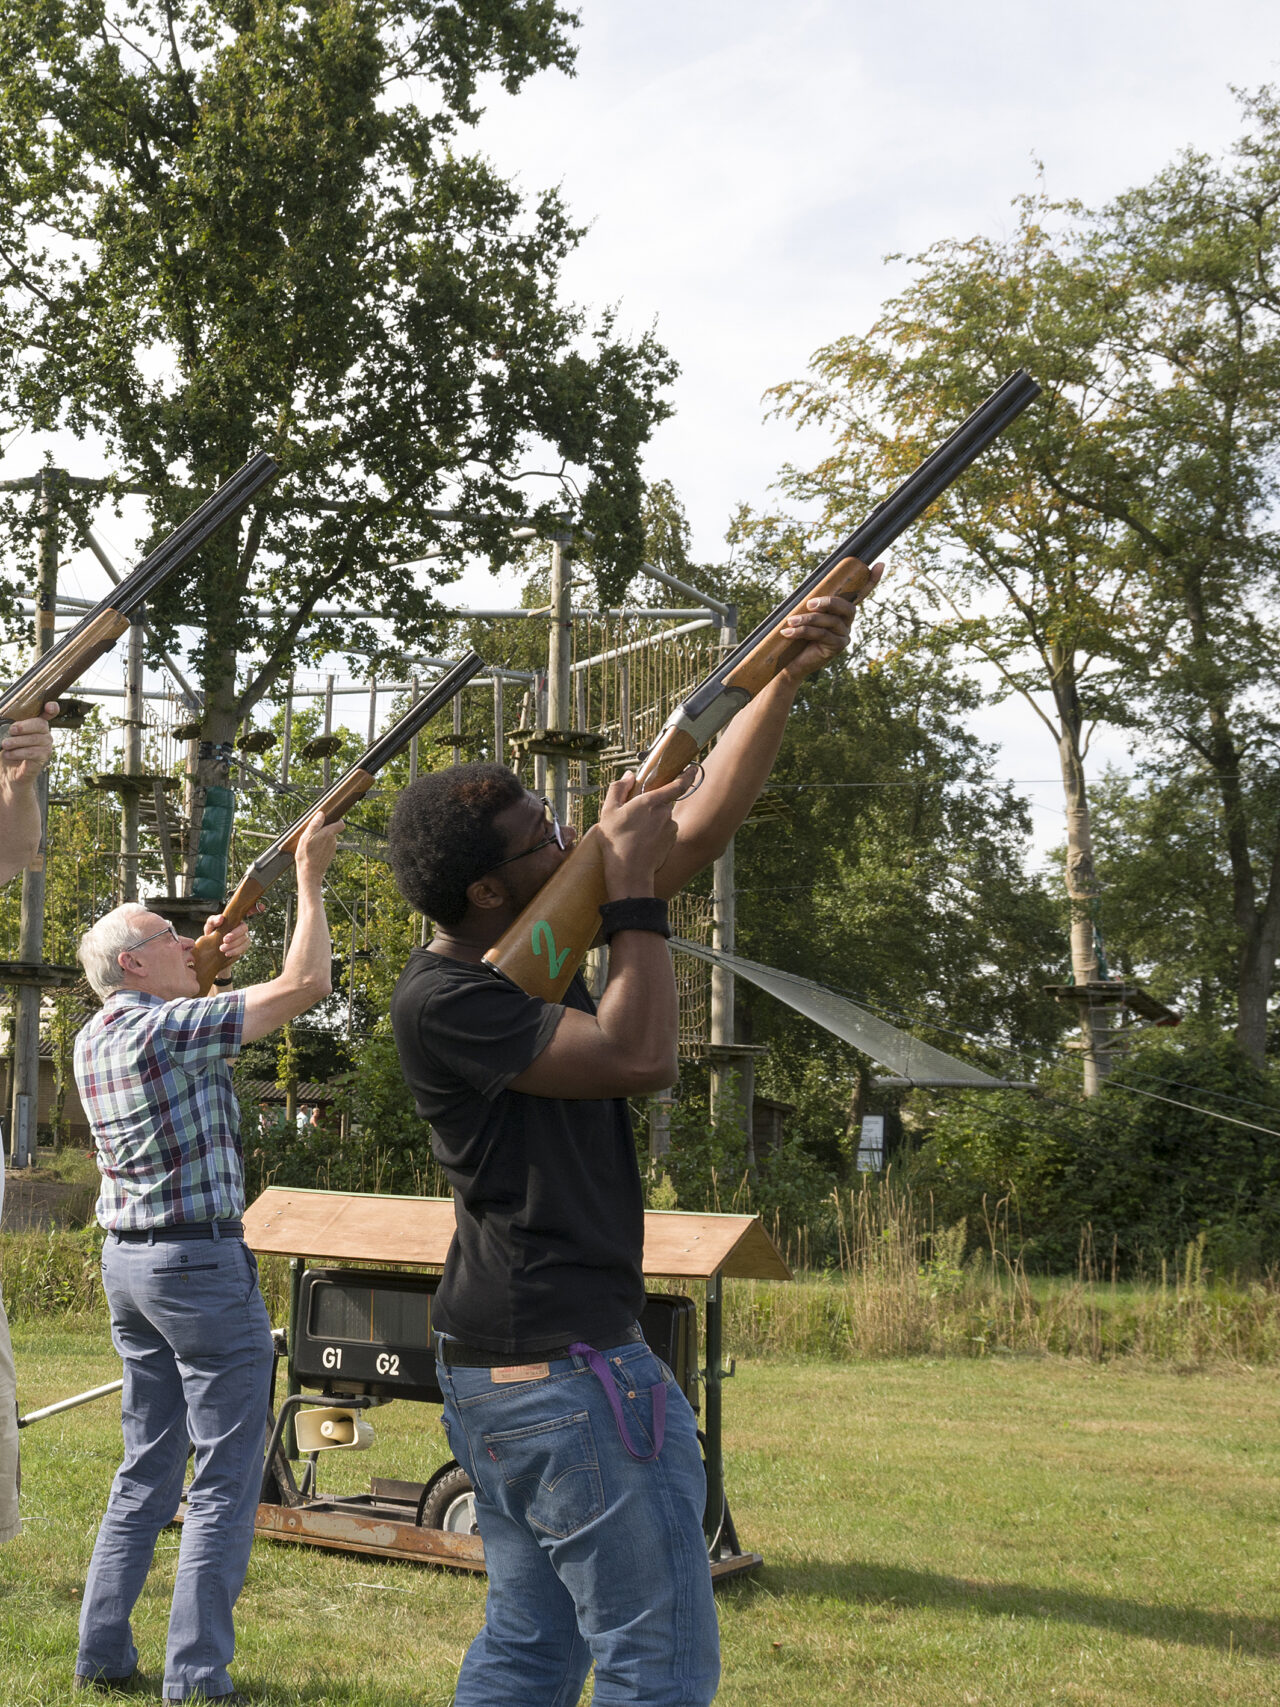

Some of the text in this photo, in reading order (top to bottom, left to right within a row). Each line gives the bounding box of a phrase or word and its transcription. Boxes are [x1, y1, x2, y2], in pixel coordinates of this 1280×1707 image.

[531, 919, 572, 980] 2
[322, 1347, 400, 1376] G1 G2
